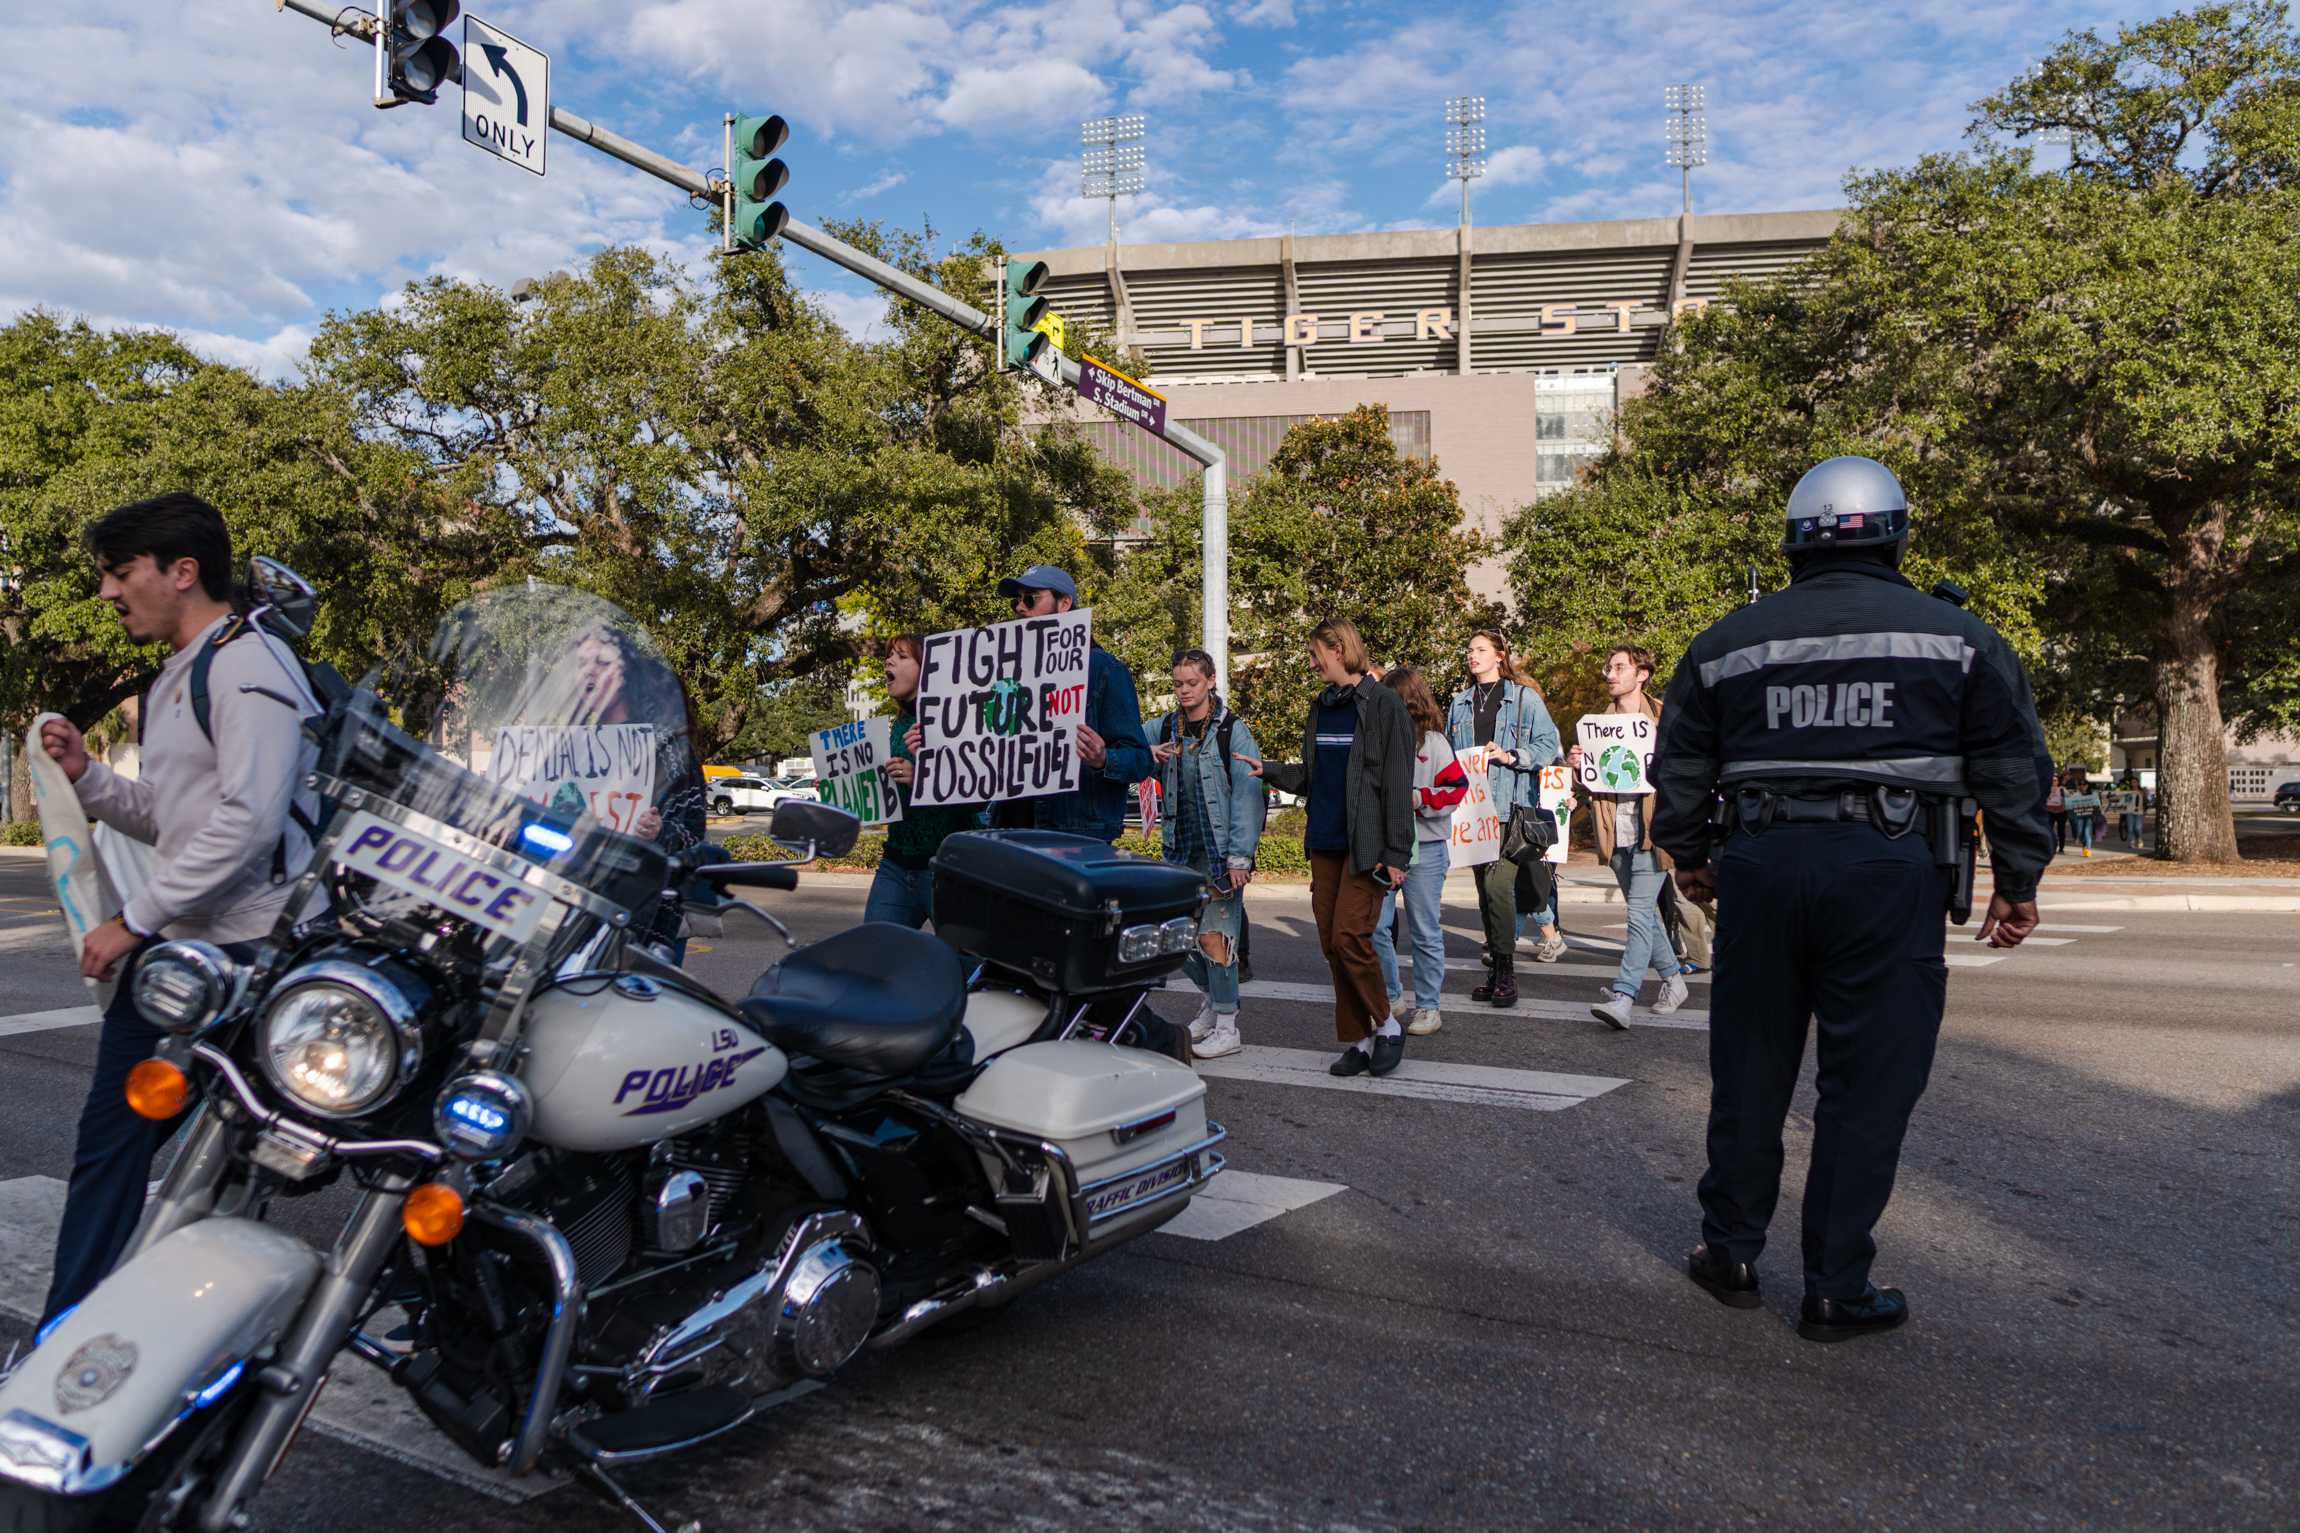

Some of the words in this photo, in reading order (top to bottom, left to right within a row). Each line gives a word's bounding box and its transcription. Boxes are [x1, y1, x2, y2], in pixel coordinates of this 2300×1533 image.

[476, 114, 535, 158] ONLY
[1179, 307, 1456, 349] TIGER
[1093, 387, 1102, 403] S.
[1104, 392, 1140, 421] Stadium
[1095, 368, 1116, 392] Skip
[1117, 379, 1152, 409] Bertman
[921, 619, 1060, 693] FIGHT
[1047, 623, 1086, 652] FOR
[1046, 647, 1083, 674] OUR
[918, 683, 1056, 748] FUTURE
[1048, 684, 1085, 717] NOT
[1766, 682, 1895, 729] POLICE
[820, 720, 866, 750] THERE
[1583, 722, 1624, 739] There
[1632, 720, 1649, 738] IS
[497, 727, 580, 785] DENIAL
[585, 724, 611, 778] IS
[617, 727, 652, 786] NOT
[826, 749, 850, 778] IS
[854, 742, 873, 768] NO
[820, 768, 880, 821] PLANET
[877, 765, 898, 818] B
[347, 825, 535, 925] POLICE
[712, 1028, 739, 1052] LSU
[613, 1054, 742, 1104] POLICE
[1087, 1184, 1135, 1212] RAFFIC
